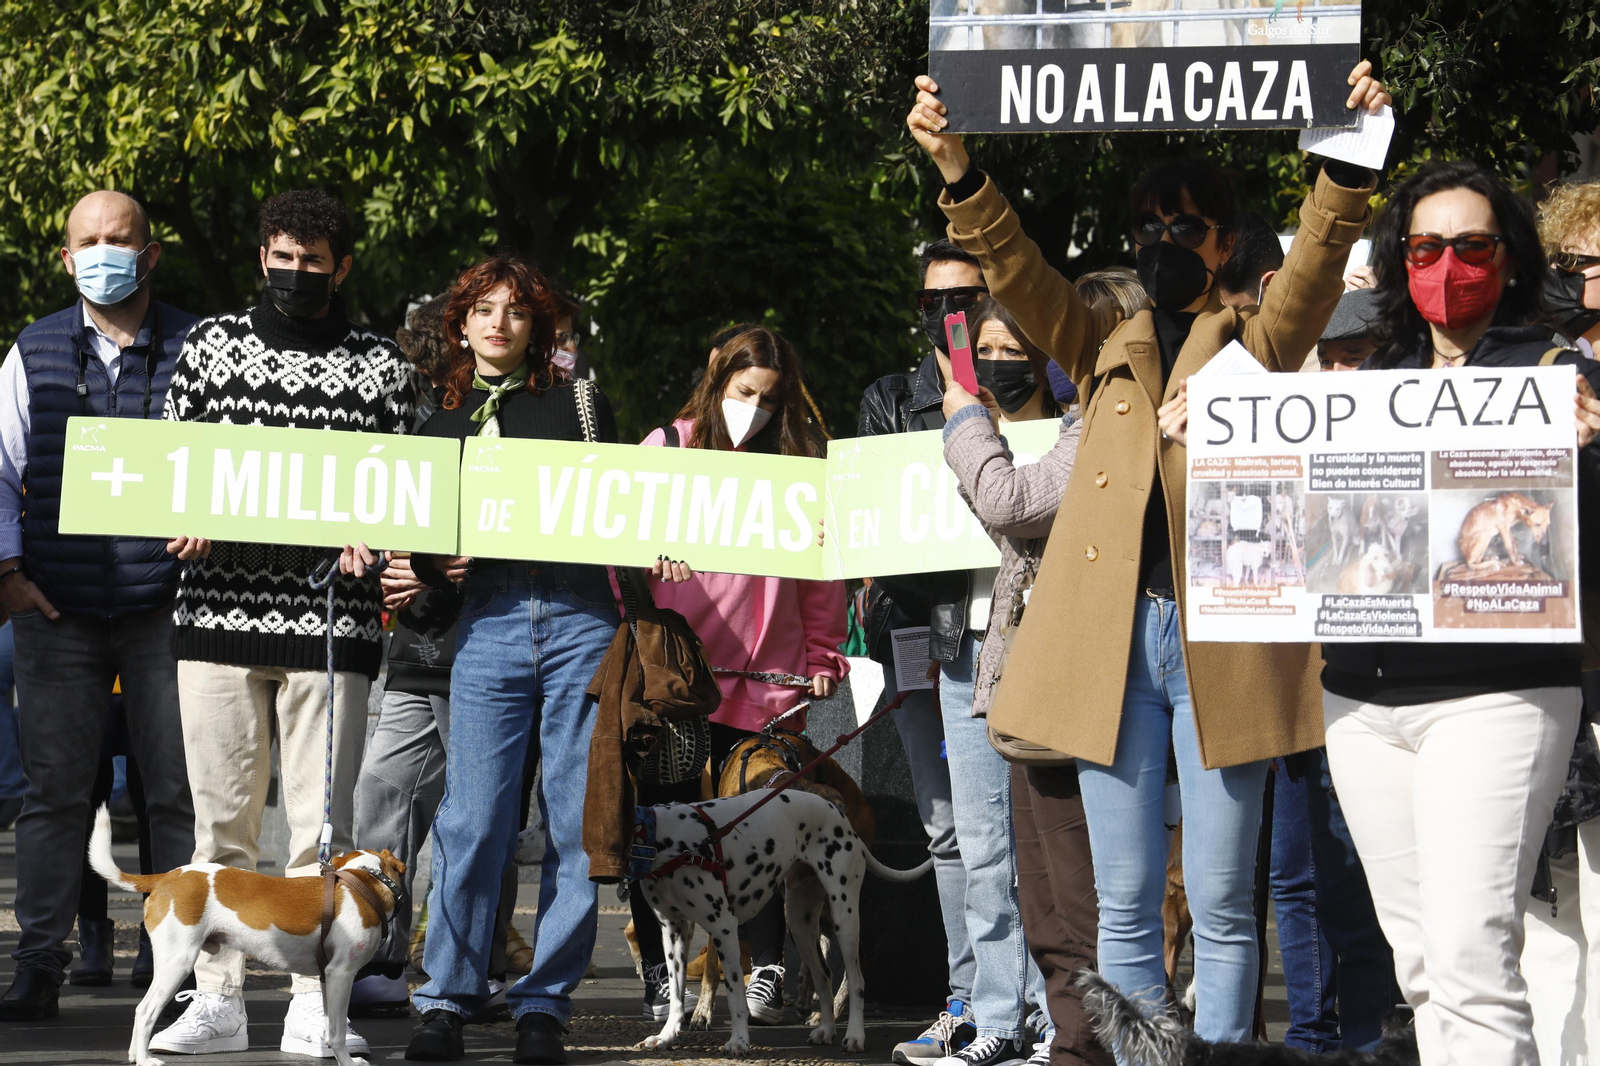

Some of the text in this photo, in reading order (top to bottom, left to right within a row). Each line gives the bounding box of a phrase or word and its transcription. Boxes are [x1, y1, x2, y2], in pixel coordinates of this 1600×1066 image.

[1248, 23, 1331, 39] Galgos del Sur
[1000, 60, 1313, 124] NO A LA CAZA
[1206, 376, 1552, 446] STOP CAZA
[72, 444, 106, 453] PACMA
[1449, 450, 1468, 458] Caza
[1468, 450, 1500, 458] esconde
[1194, 458, 1206, 466] LA
[1206, 458, 1231, 466] CAZA:
[1234, 457, 1269, 467] Maltrato,
[1313, 453, 1421, 465] La crueldad y la muerte
[1449, 459, 1487, 469] abandono,
[1514, 461, 1519, 469] y
[1520, 458, 1557, 468] desprecio
[468, 465, 500, 473] PACMA
[1192, 468, 1225, 477] crueldad
[1226, 470, 1231, 478] y
[1232, 468, 1269, 477] asesinato
[1312, 465, 1422, 478] no pueden considerarse
[1454, 469, 1487, 478] absoluto
[1487, 470, 1500, 479] por
[1501, 469, 1509, 477] la
[1509, 468, 1525, 477] vida
[832, 472, 862, 482] PACMA
[1311, 477, 1420, 488] Bien de Interés Cultural
[166, 446, 190, 513] 1
[211, 444, 432, 528] MILLÓN
[477, 454, 818, 552] DE VÍCTIMAS
[849, 507, 881, 549] EN
[1443, 583, 1563, 596] #RespetoVidaAnimal
[1324, 596, 1412, 609] #LaCazaEsMuerte
[1466, 599, 1540, 611] #NoALaCaza
[1319, 609, 1417, 622] #LaCazaEsViolencia
[1317, 622, 1417, 635] #RespetoVidaAnimal
